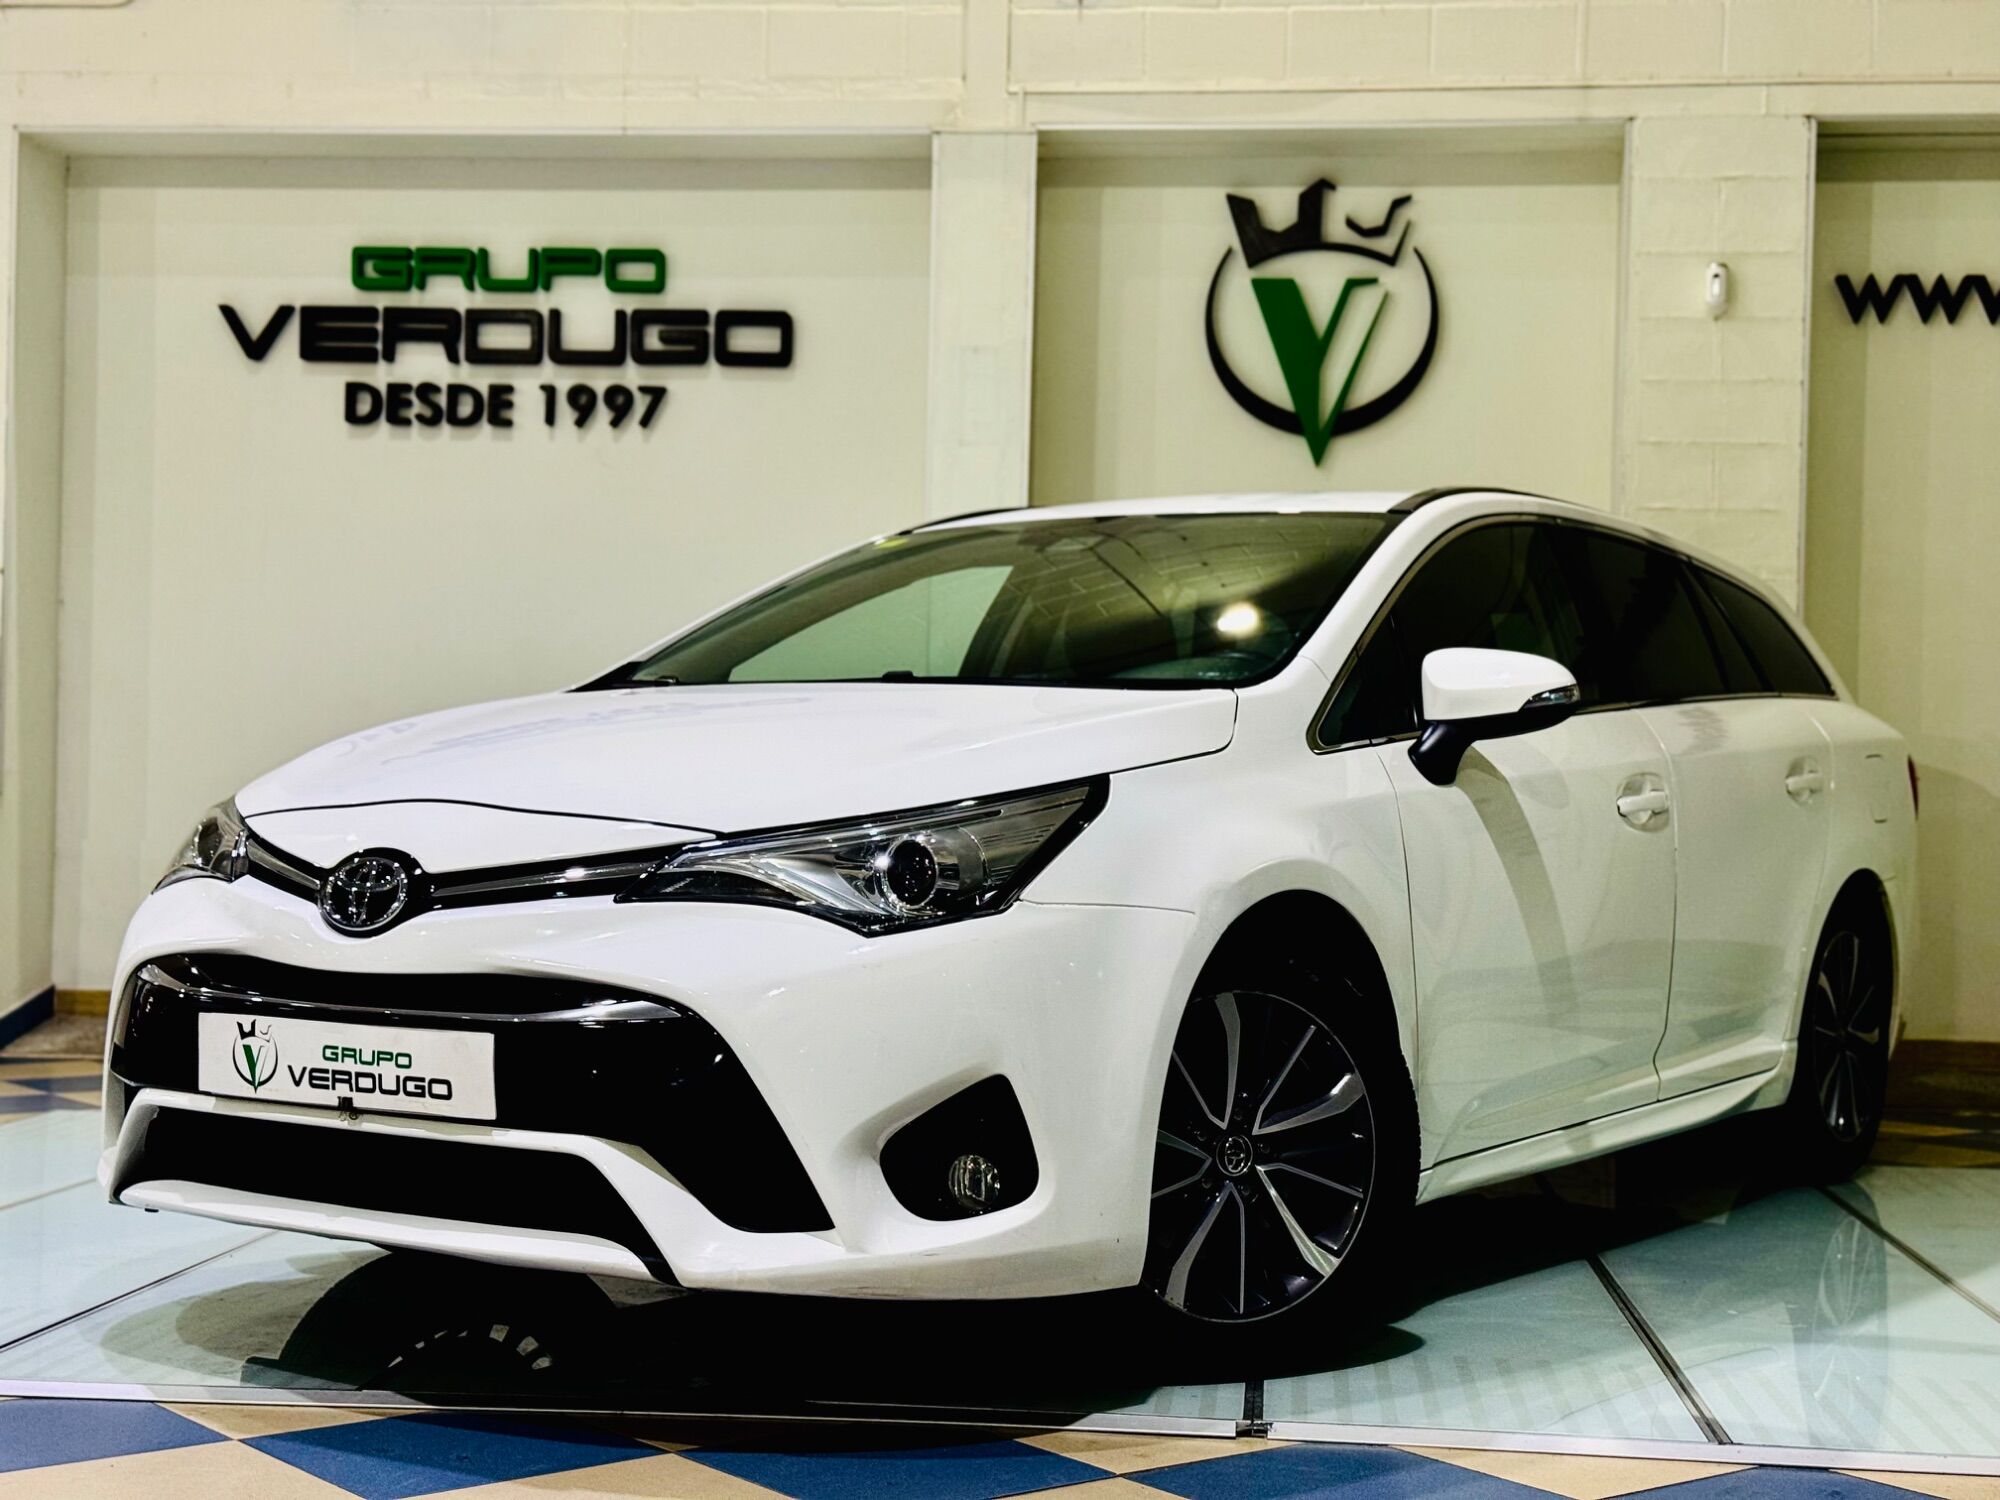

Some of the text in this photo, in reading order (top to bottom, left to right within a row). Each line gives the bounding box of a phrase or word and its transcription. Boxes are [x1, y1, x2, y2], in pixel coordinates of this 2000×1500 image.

[351, 246, 667, 294] GRUPO
[218, 303, 794, 368] VERDUGO
[344, 381, 668, 428] DESDE 1997
[322, 1044, 413, 1070] GRUPO
[287, 1064, 453, 1101] VERDUGO
